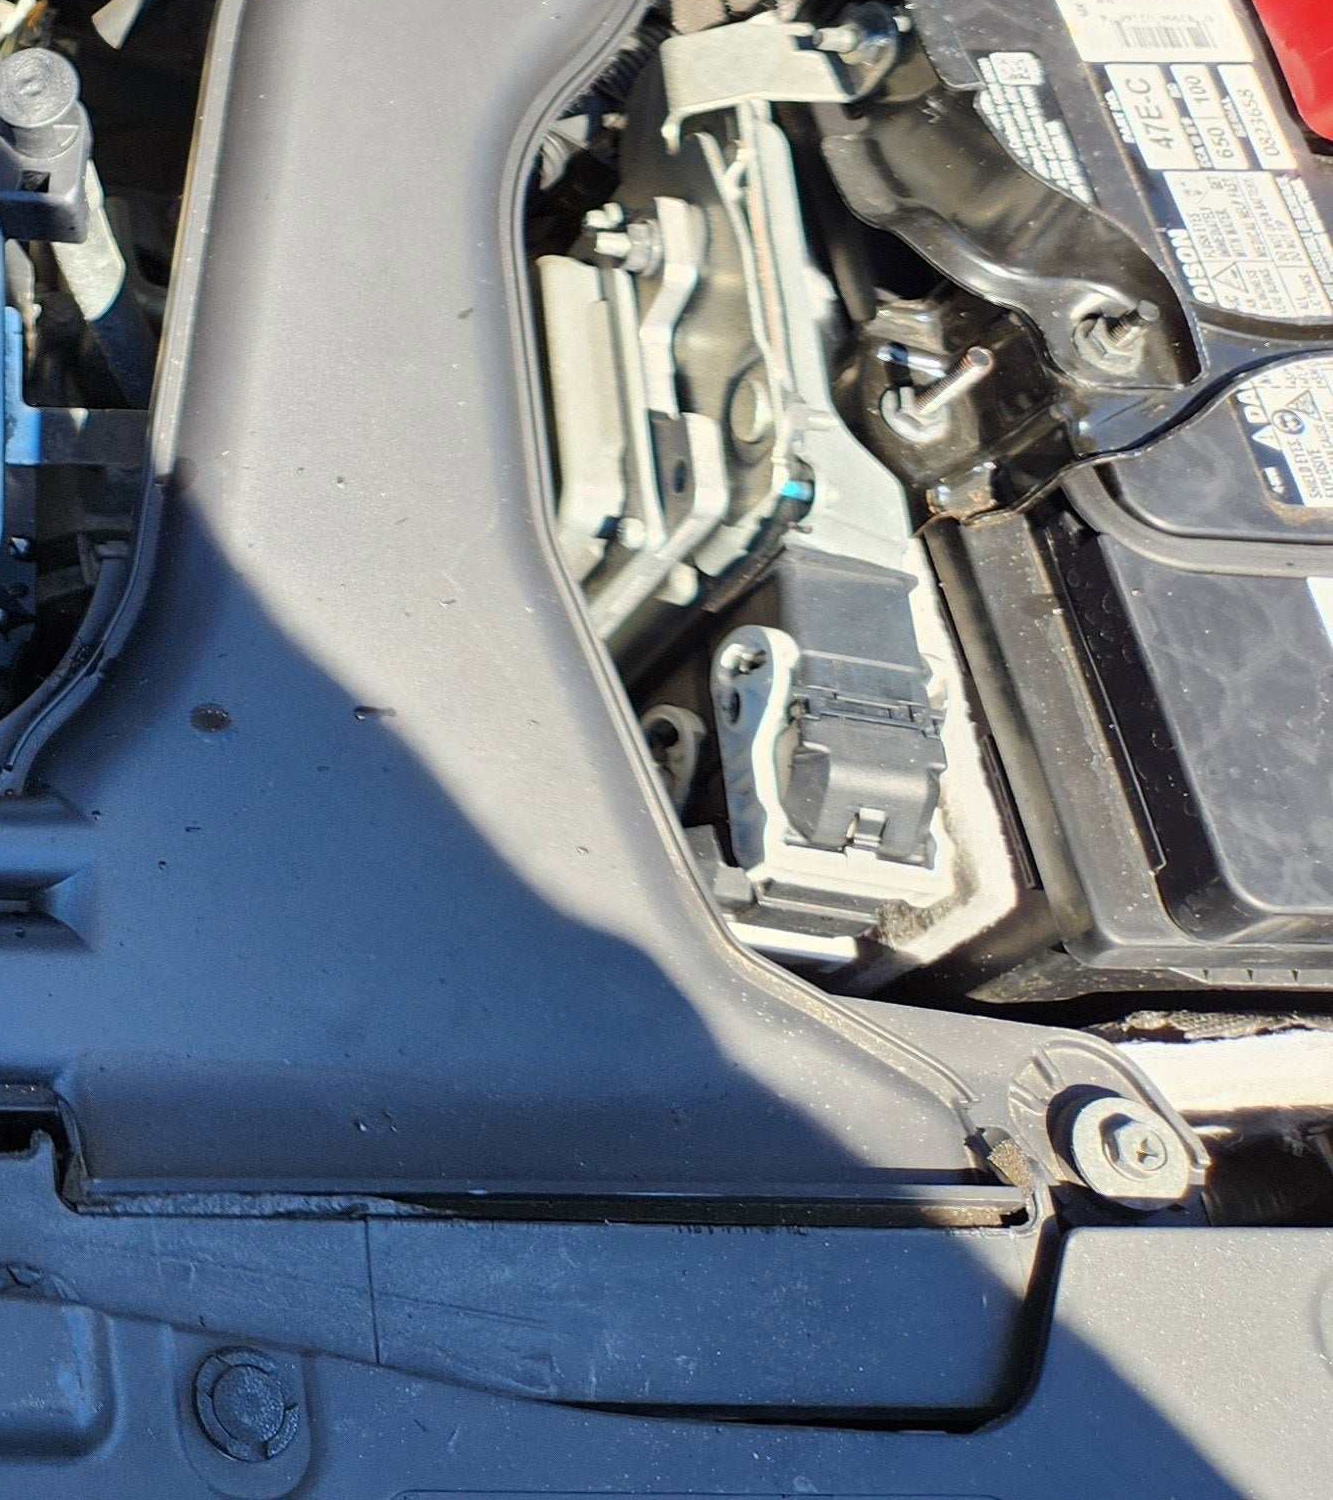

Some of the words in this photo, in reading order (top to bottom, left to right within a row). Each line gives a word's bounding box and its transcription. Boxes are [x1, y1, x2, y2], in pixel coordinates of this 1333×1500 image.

[1182, 75, 1211, 104] 100
[1122, 78, 1177, 148] 47E-C
[1205, 127, 1235, 157] 650
